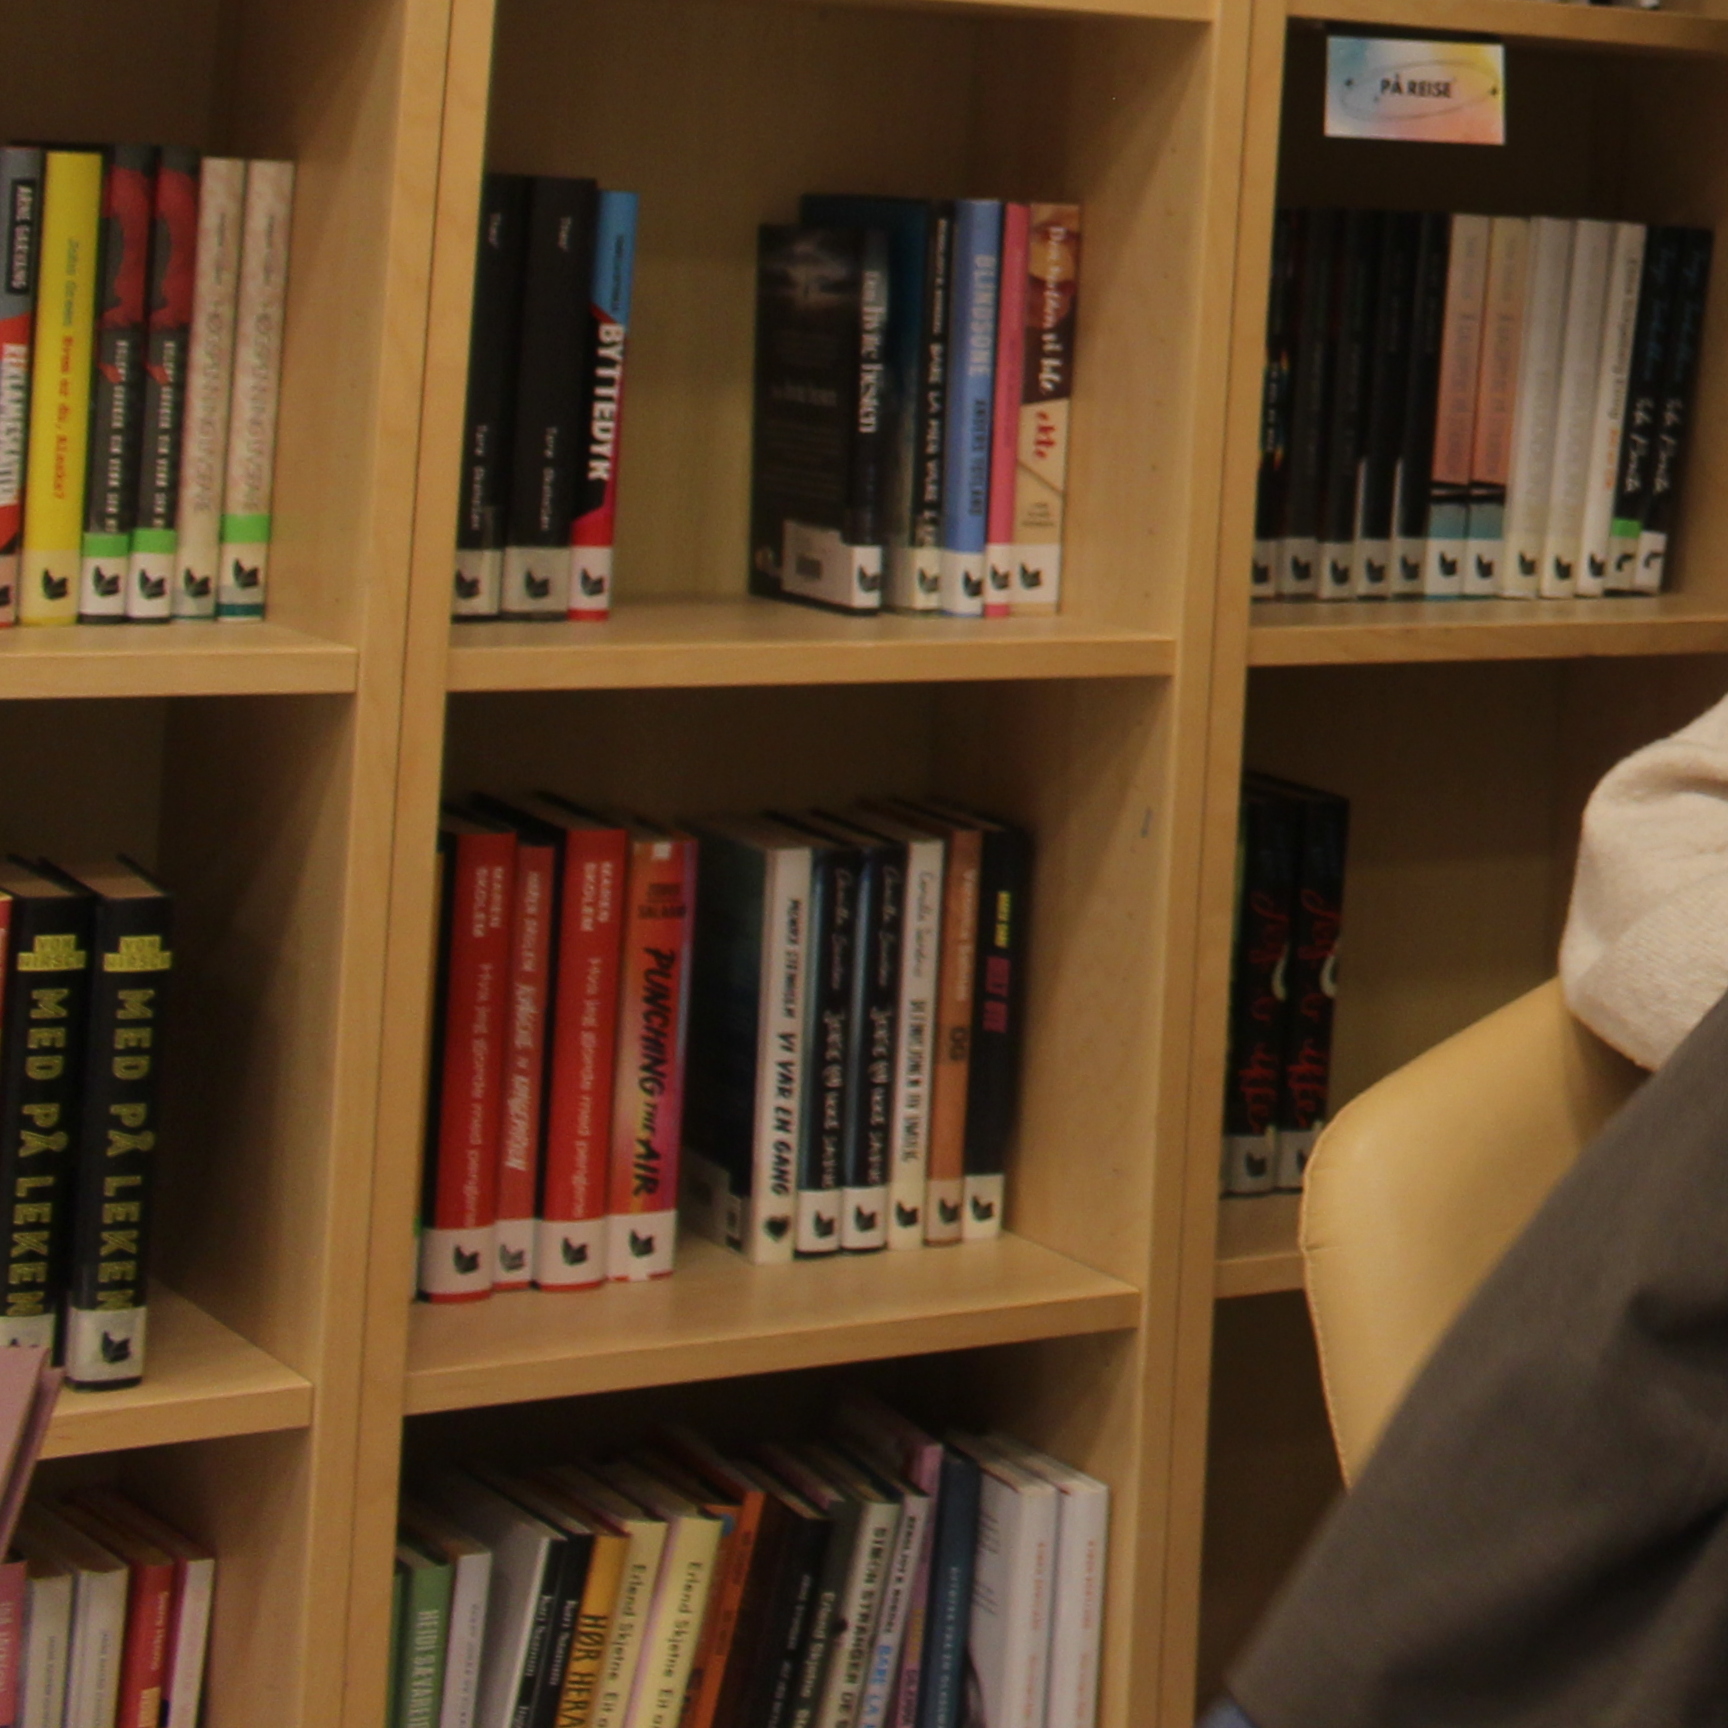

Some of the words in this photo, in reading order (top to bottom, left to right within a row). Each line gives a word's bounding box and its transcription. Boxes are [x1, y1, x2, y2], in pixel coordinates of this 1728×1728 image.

[1379, 73, 1404, 96] PÅ
[1407, 77, 1452, 99] REISE
[968, 253, 997, 378] BLINDSONE
[26, 988, 70, 1081] MED
[111, 988, 156, 1081] MED
[637, 946, 676, 1098] PUNCHING
[778, 1031, 798, 1052] VI
[775, 1060, 796, 1100] VAR
[18, 1102, 68, 1158] PÅ
[106, 1102, 156, 1158] PÅ
[641, 1102, 660, 1137] THE
[773, 1105, 794, 1133] EN
[631, 1138, 663, 1198] AIR
[769, 1139, 793, 1199] GANG
[863, 1526, 890, 1585] SIMON
[621, 1563, 648, 1618] Erlend
[677, 1560, 705, 1615] Erlend
[571, 1614, 609, 1662] HØR
